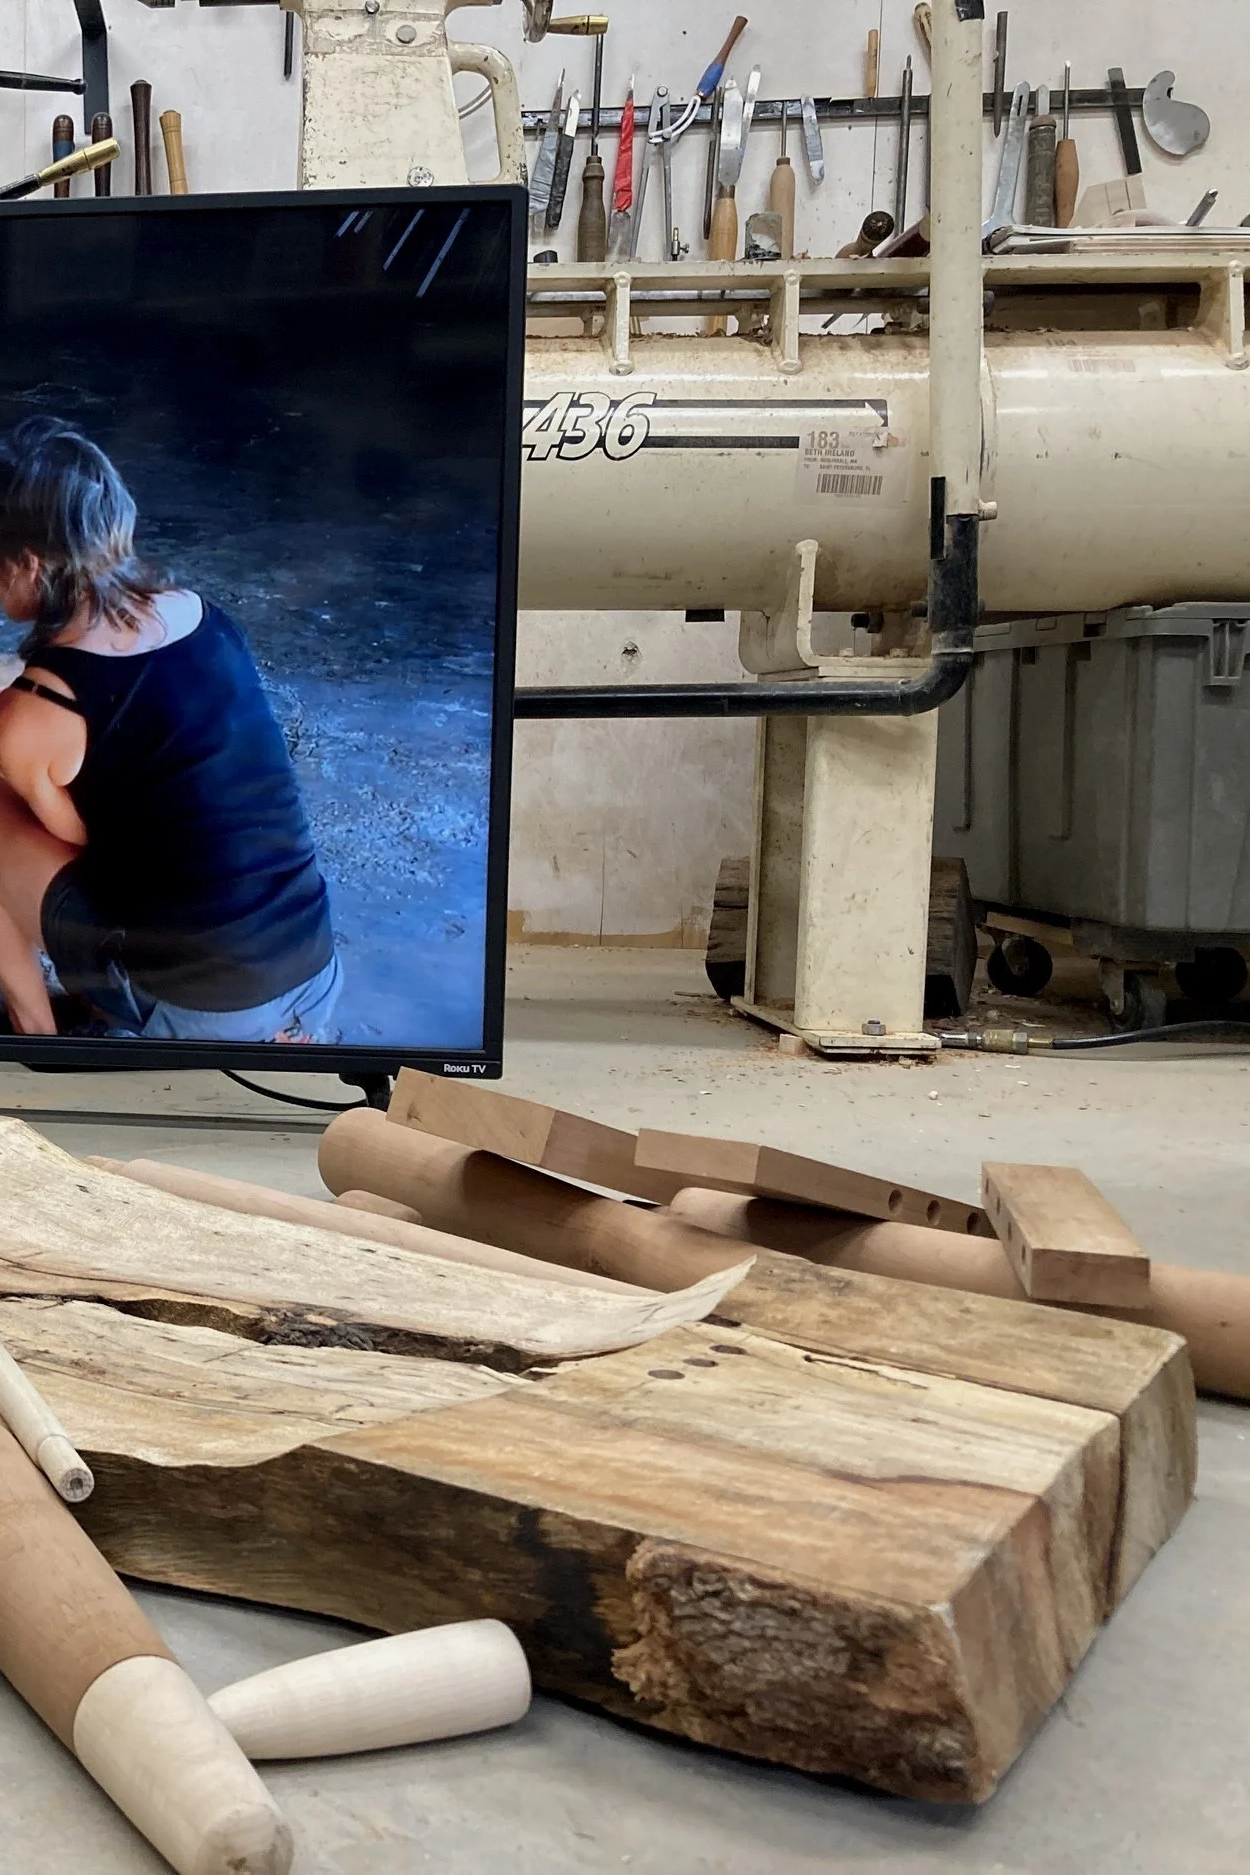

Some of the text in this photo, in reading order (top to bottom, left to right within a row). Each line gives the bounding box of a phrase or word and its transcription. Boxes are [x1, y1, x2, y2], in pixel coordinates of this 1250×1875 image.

[522, 391, 658, 462] 436
[806, 430, 840, 449] 183
[804, 448, 855, 457] BETH IRELAND
[472, 1064, 487, 1074] TV
